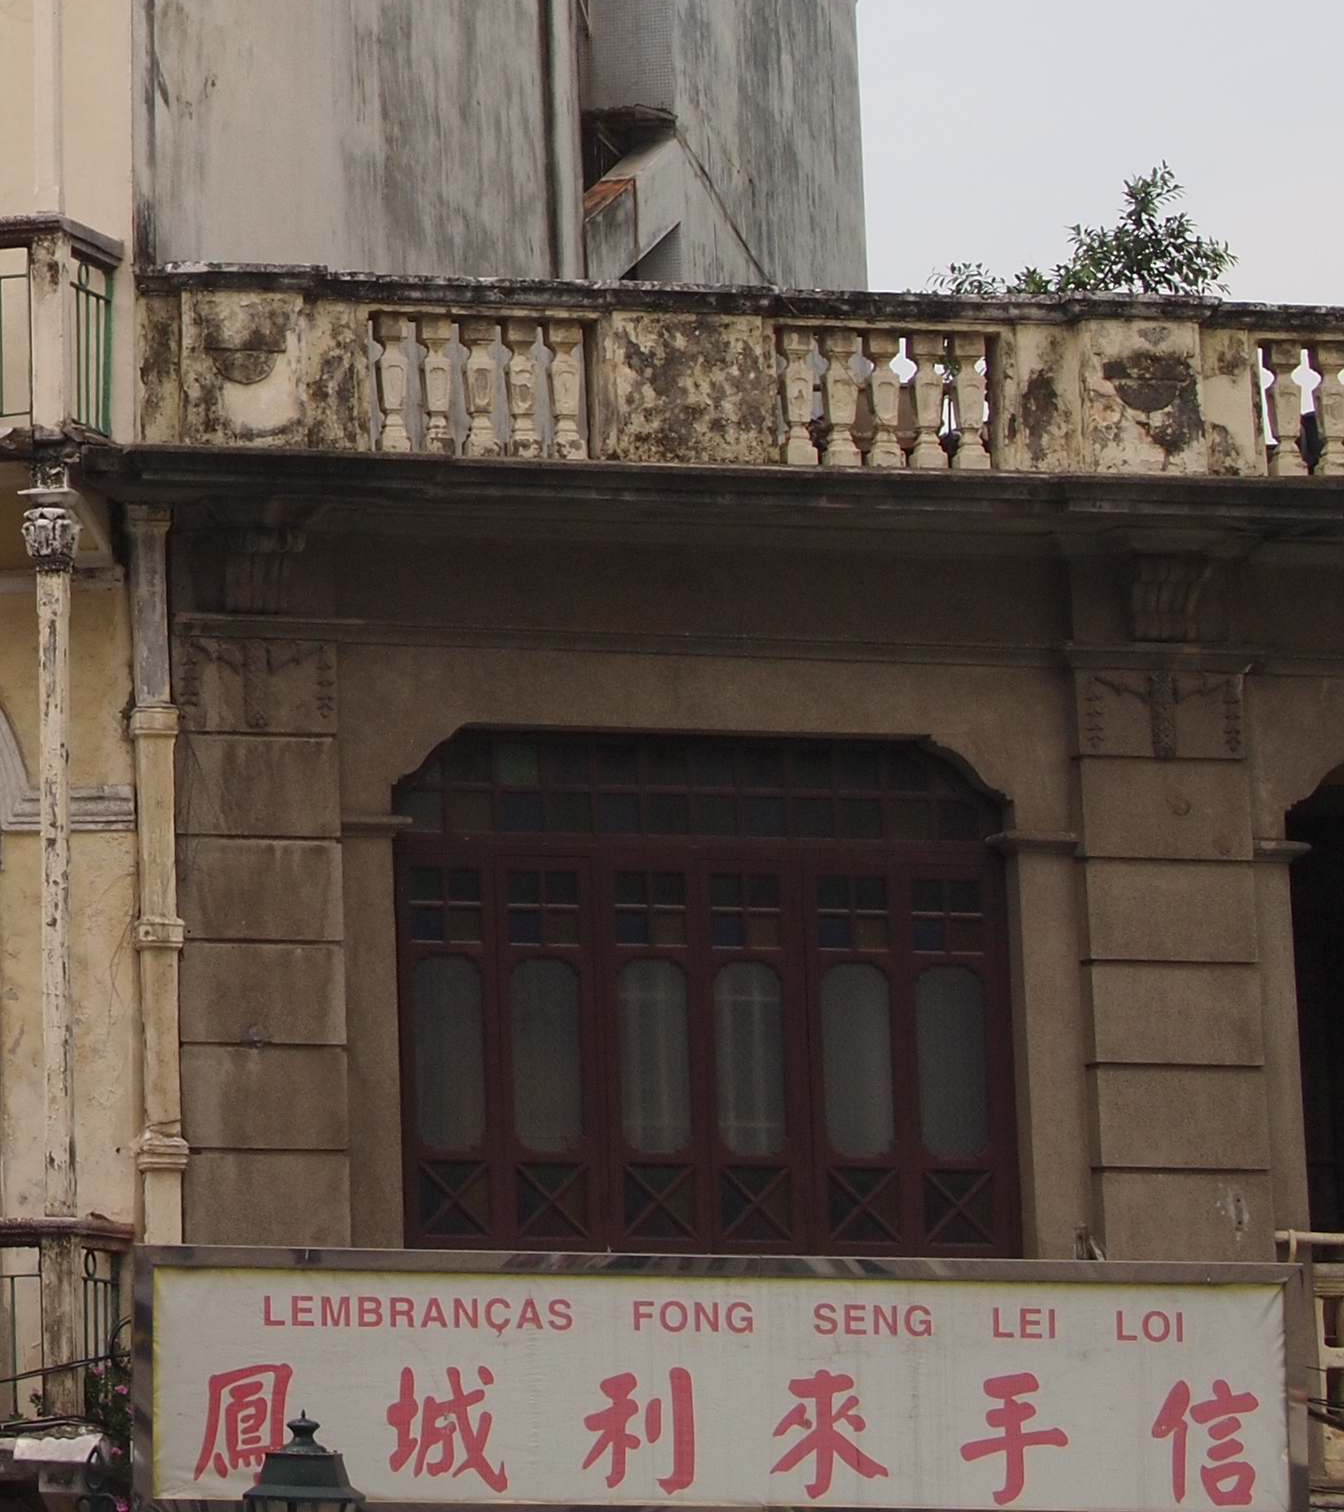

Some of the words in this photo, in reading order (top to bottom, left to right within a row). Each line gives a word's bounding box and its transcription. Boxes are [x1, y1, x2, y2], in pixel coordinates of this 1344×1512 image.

[262, 1295, 574, 1338] LEMBRANÇAS
[632, 1300, 754, 1334] FONG
[813, 1303, 933, 1337] SENG
[992, 1307, 1057, 1340] LEI
[1115, 1310, 1184, 1343] LOI
[193, 1362, 1259, 1506] 鳳城利來手信
